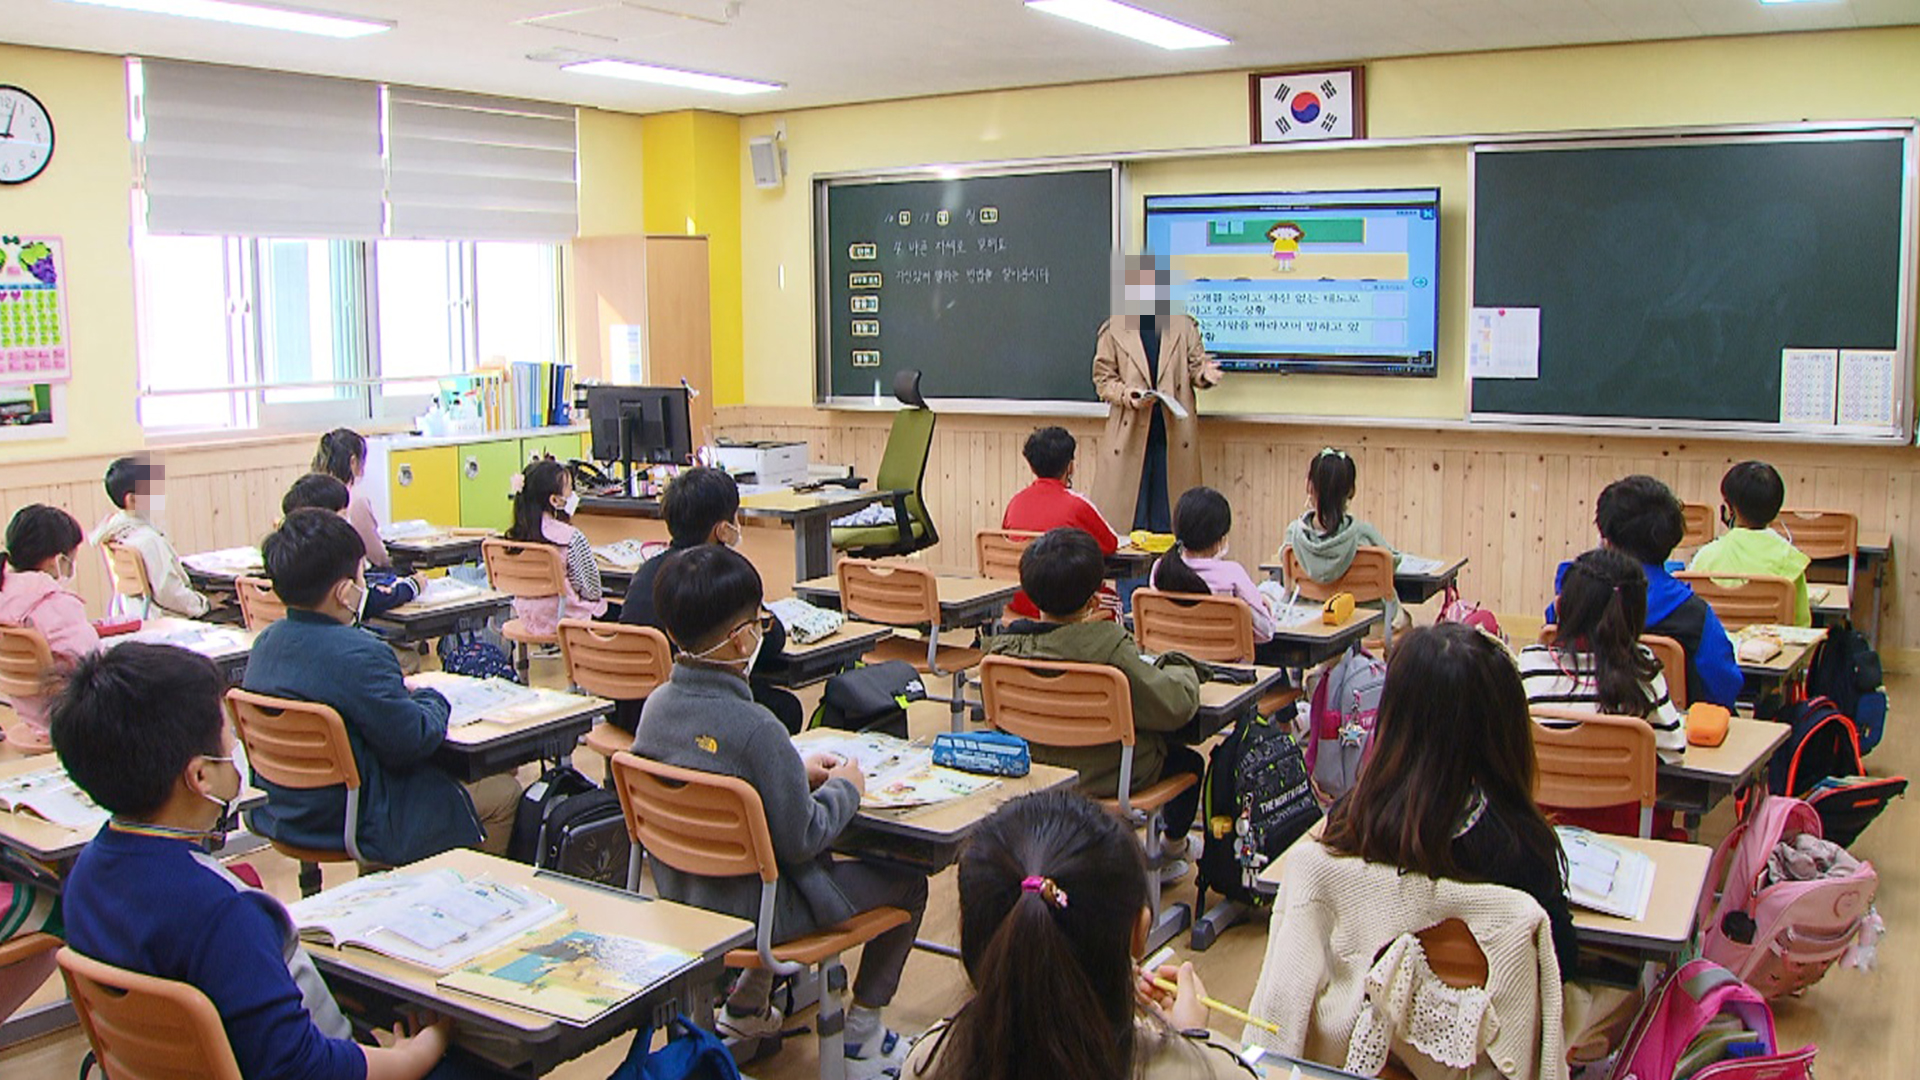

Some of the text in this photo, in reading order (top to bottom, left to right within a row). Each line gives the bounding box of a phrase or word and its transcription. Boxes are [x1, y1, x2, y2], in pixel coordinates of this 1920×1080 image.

[1189, 292, 1222, 303] 고개를
[1228, 292, 1263, 304] 숙이고
[1295, 292, 1319, 305] 없는
[1216, 304, 1239, 316] 있는
[1244, 304, 1266, 316] 상황
[1216, 319, 1250, 331] 사람을
